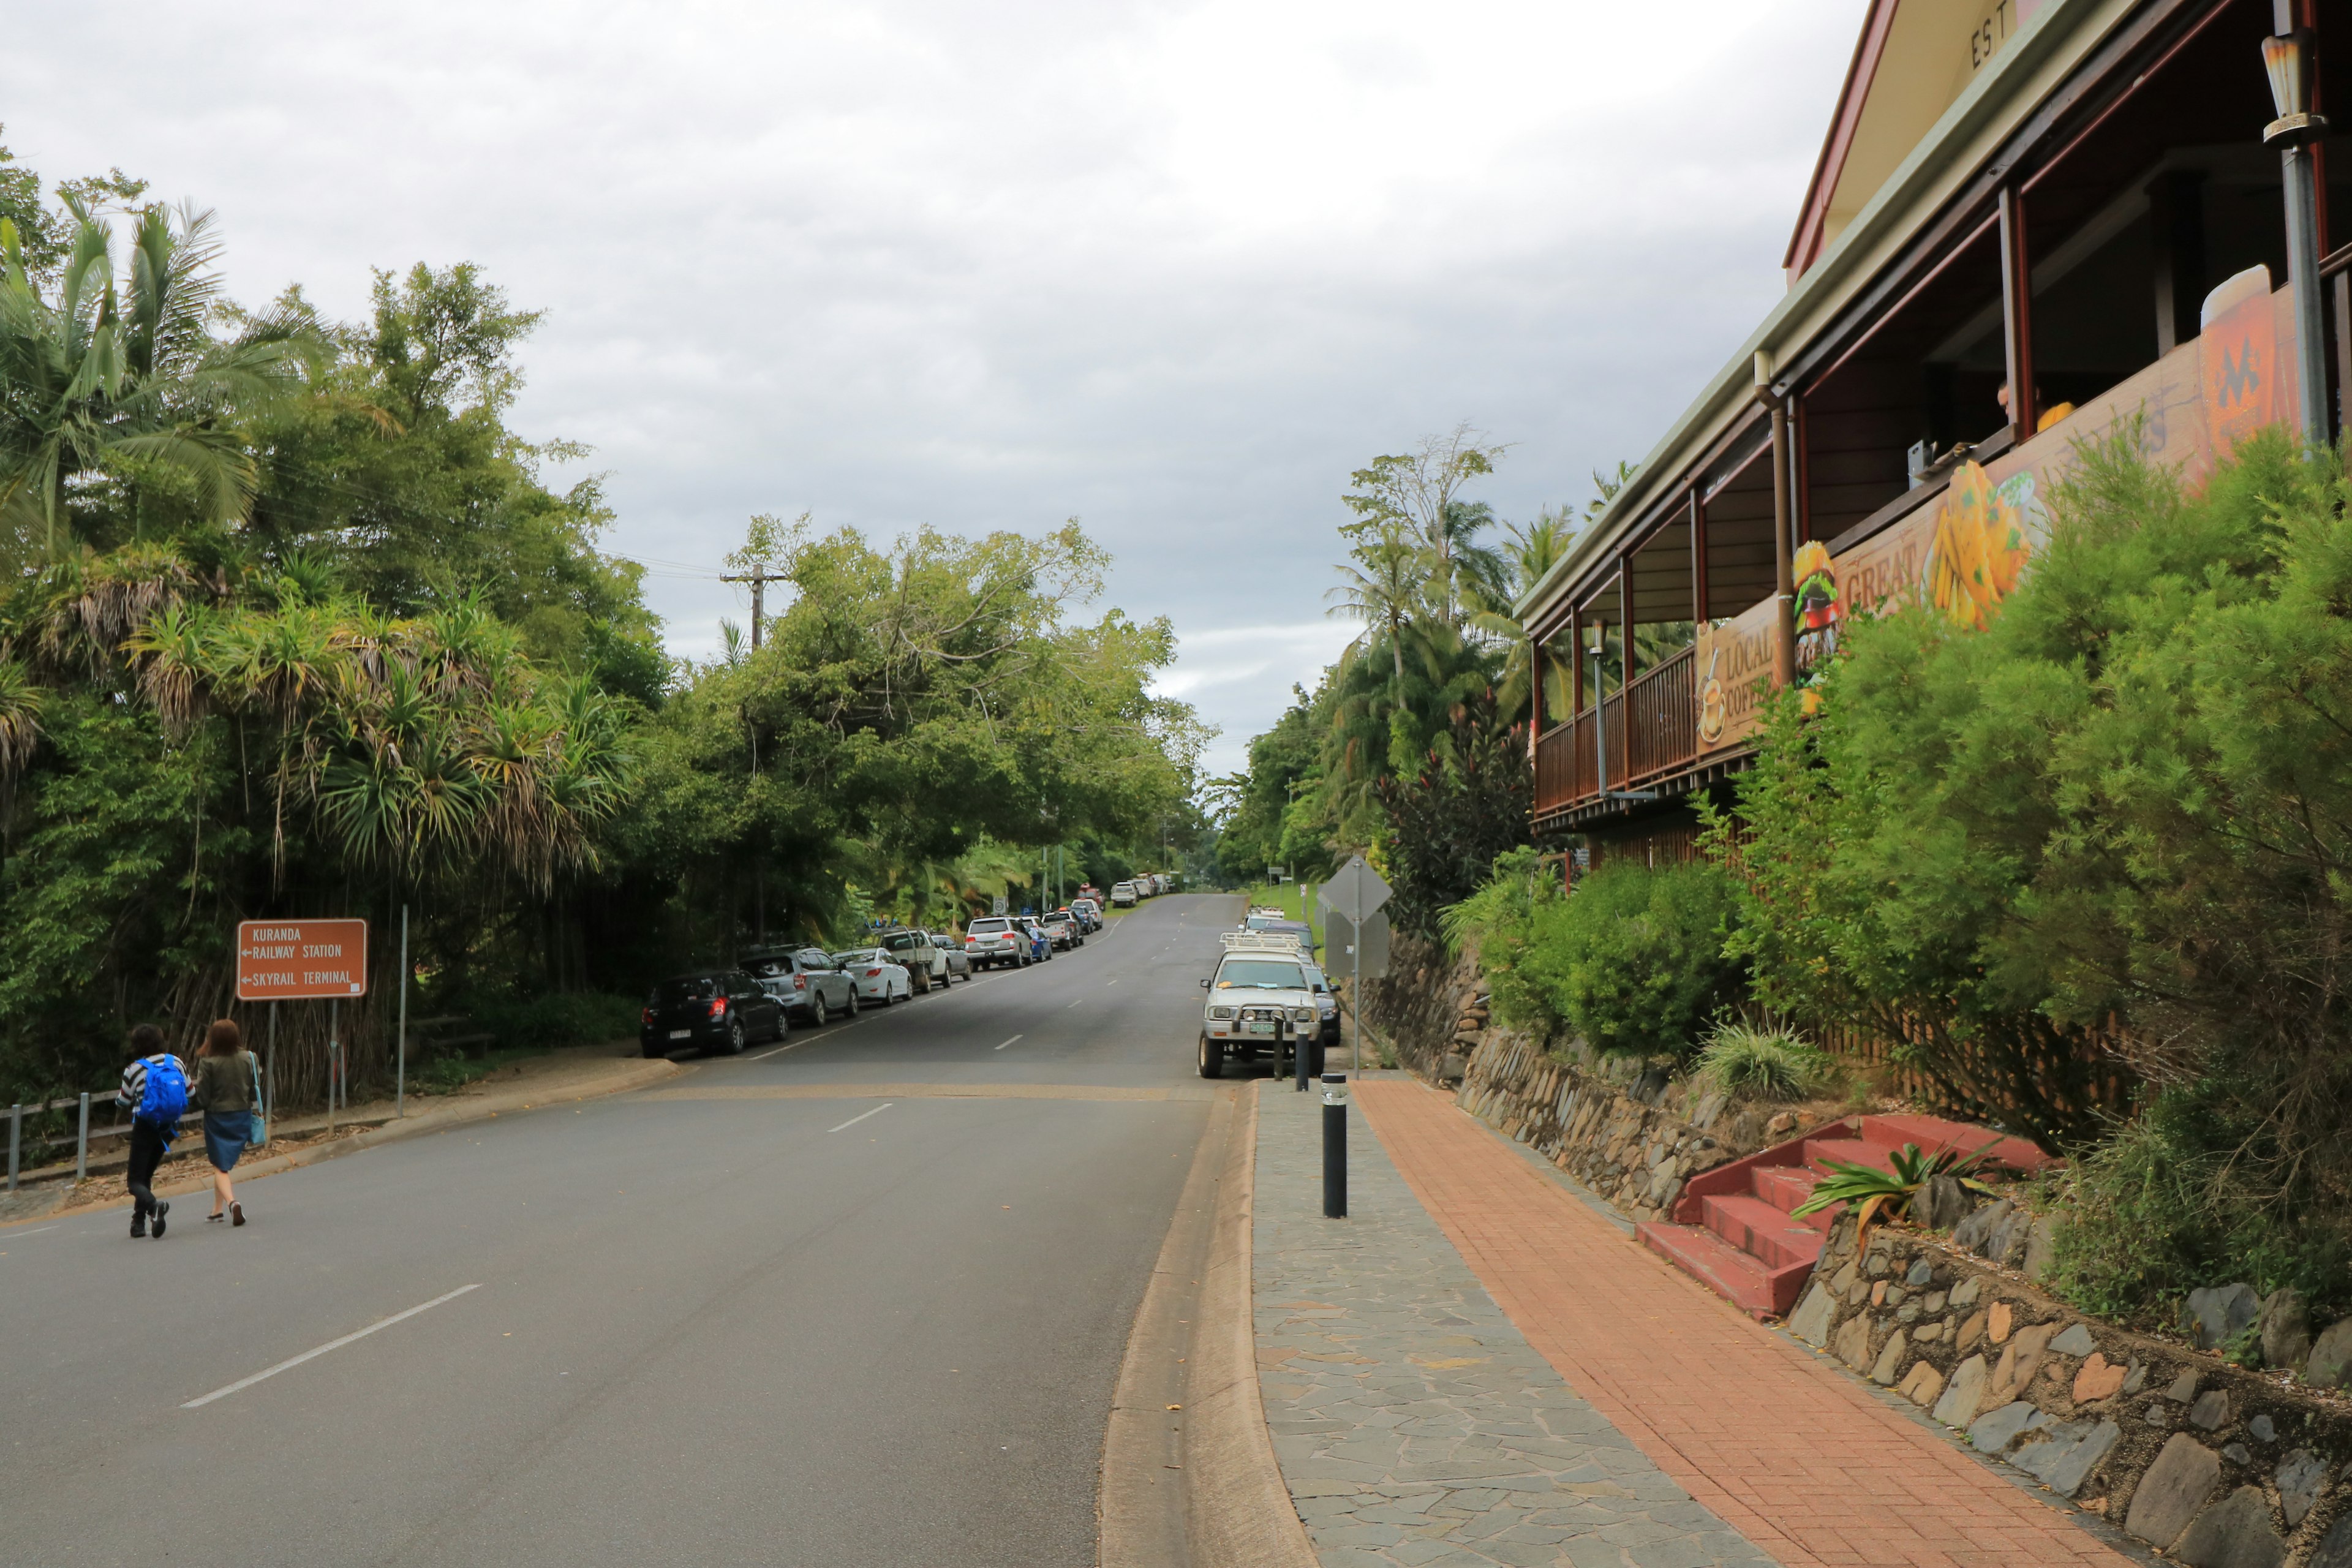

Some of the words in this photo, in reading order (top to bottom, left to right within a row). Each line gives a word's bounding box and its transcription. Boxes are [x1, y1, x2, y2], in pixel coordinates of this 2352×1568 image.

[1971, 0, 2007, 70] EST
[1846, 540, 1917, 614] GREAT
[1726, 625, 1773, 680] LOCAL
[253, 928, 301, 941] KURANDA
[253, 946, 295, 960] RAILWAY
[303, 944, 342, 958] STATION
[253, 973, 296, 986] SKYRAIL
[304, 971, 352, 984] TERMINAL
